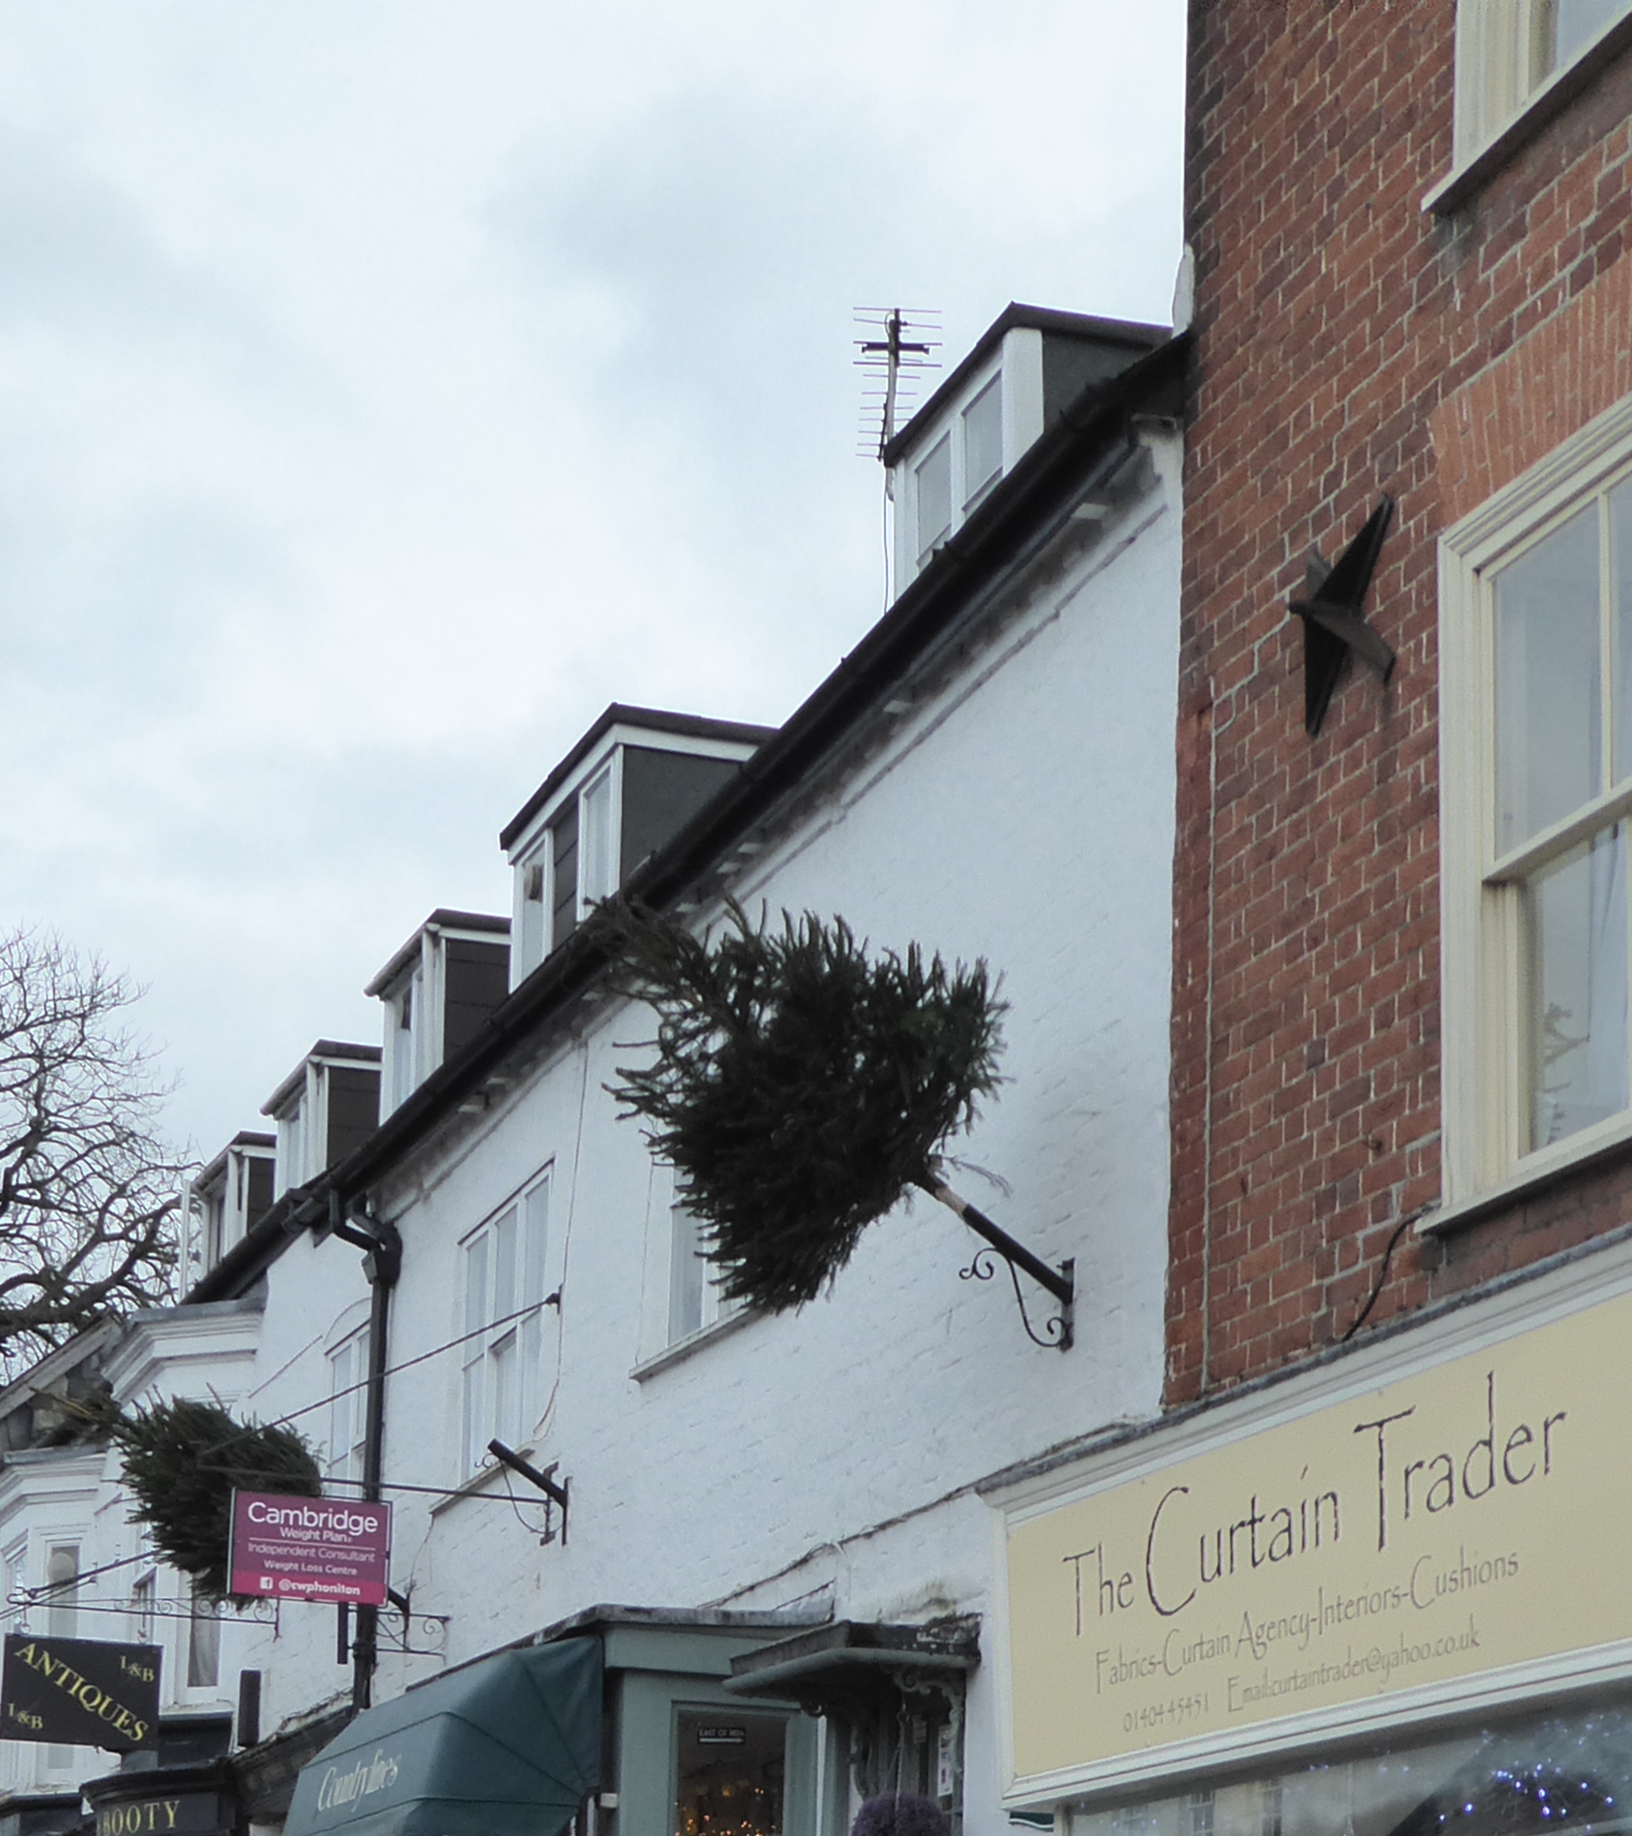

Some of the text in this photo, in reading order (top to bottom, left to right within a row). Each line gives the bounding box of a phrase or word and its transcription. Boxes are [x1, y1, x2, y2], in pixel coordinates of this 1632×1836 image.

[1062, 1370, 1569, 1637] The Curtain Trader
[248, 1501, 378, 1536] Cambridge
[279, 1527, 321, 1541] Weight
[248, 1542, 376, 1563] Independent Consultant
[264, 1560, 358, 1576] Weight Loss Centre
[14, 1642, 149, 1742] ANTIQUES
